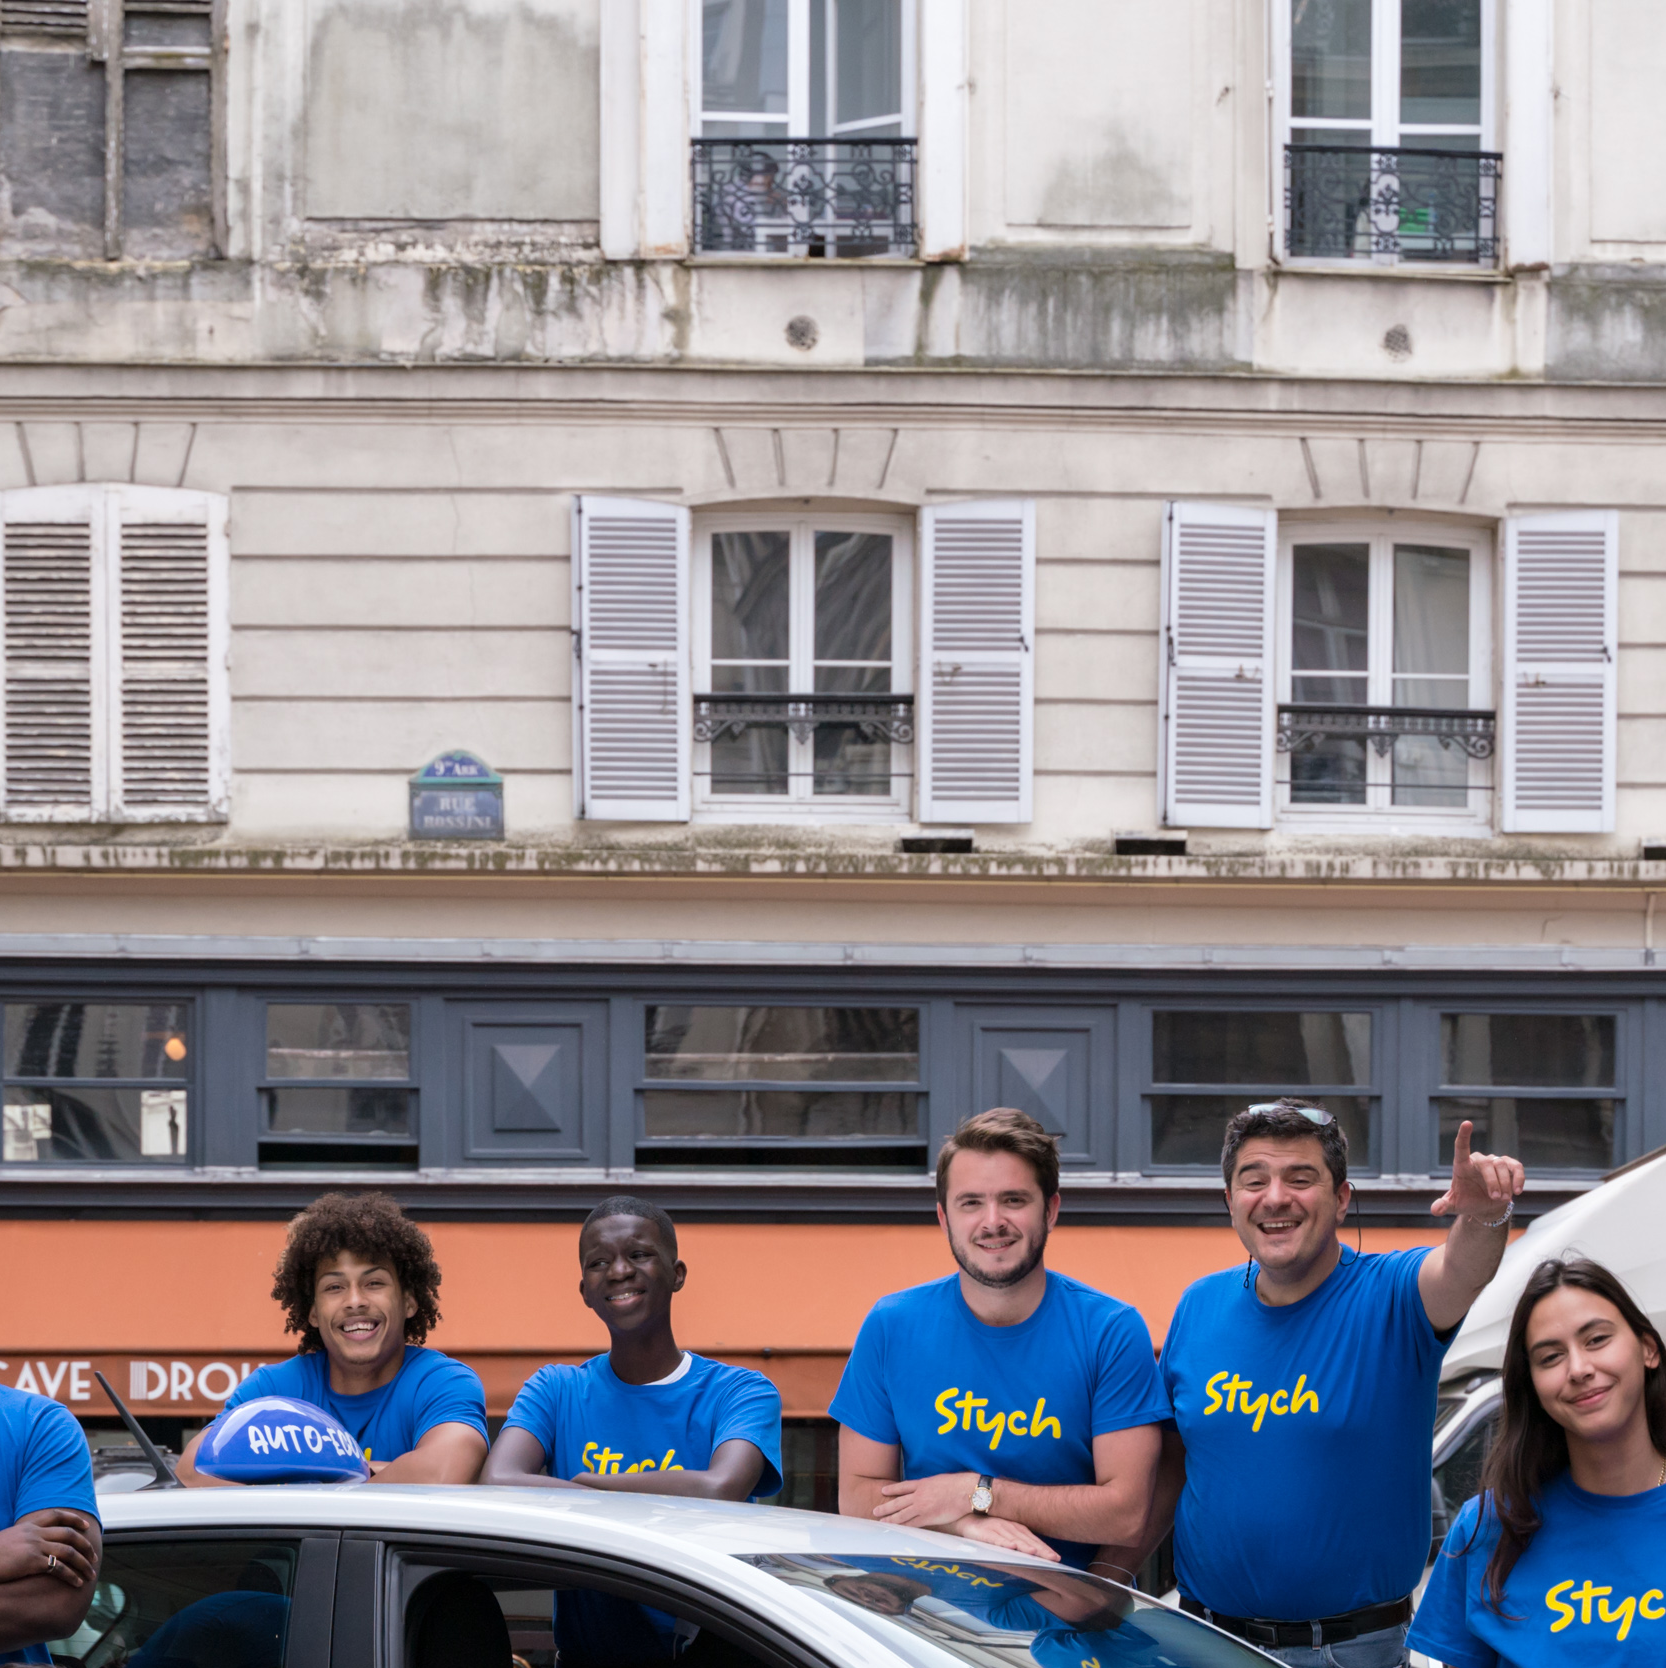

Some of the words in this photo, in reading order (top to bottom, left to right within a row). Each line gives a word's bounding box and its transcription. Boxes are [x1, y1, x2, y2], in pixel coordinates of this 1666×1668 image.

[423, 815, 492, 829] ROSSINI
[440, 797, 476, 811] RUE
[935, 1387, 1061, 1450] Stych
[1204, 1371, 1319, 1432] Stych
